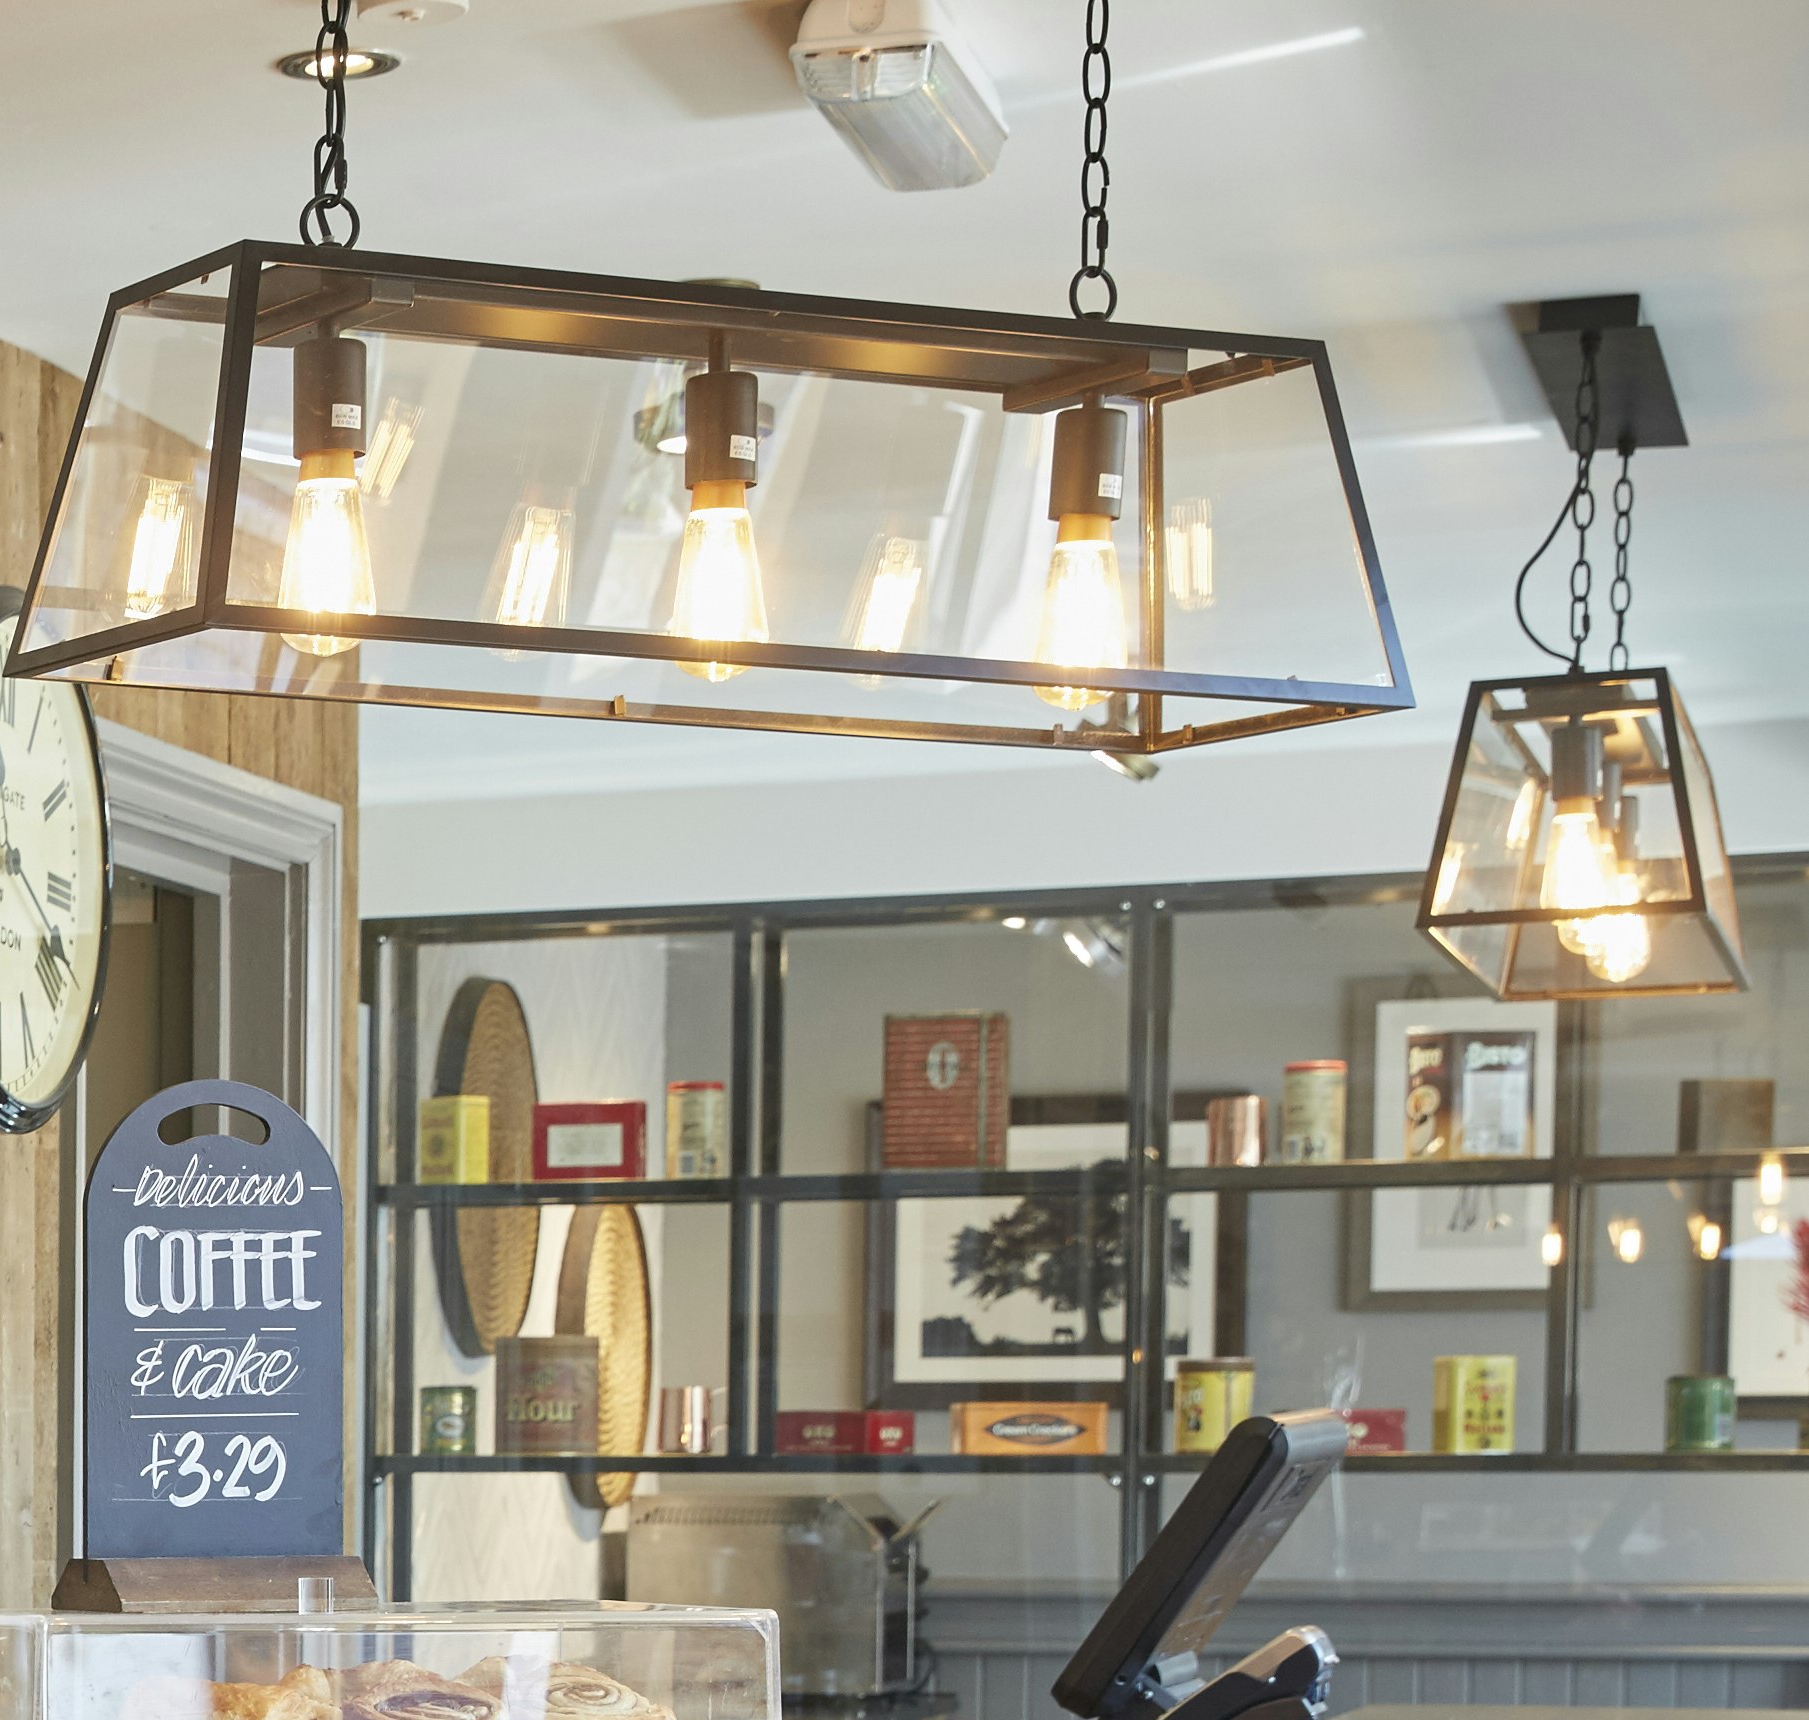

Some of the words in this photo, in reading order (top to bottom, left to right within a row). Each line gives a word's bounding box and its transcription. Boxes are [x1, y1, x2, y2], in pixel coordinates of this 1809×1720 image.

[133, 1153, 305, 1208] Delicious
[123, 1225, 323, 1318] COFFEE
[130, 1339, 165, 1396] &
[171, 1333, 300, 1400] cake
[140, 1430, 287, 1508] £3.29
